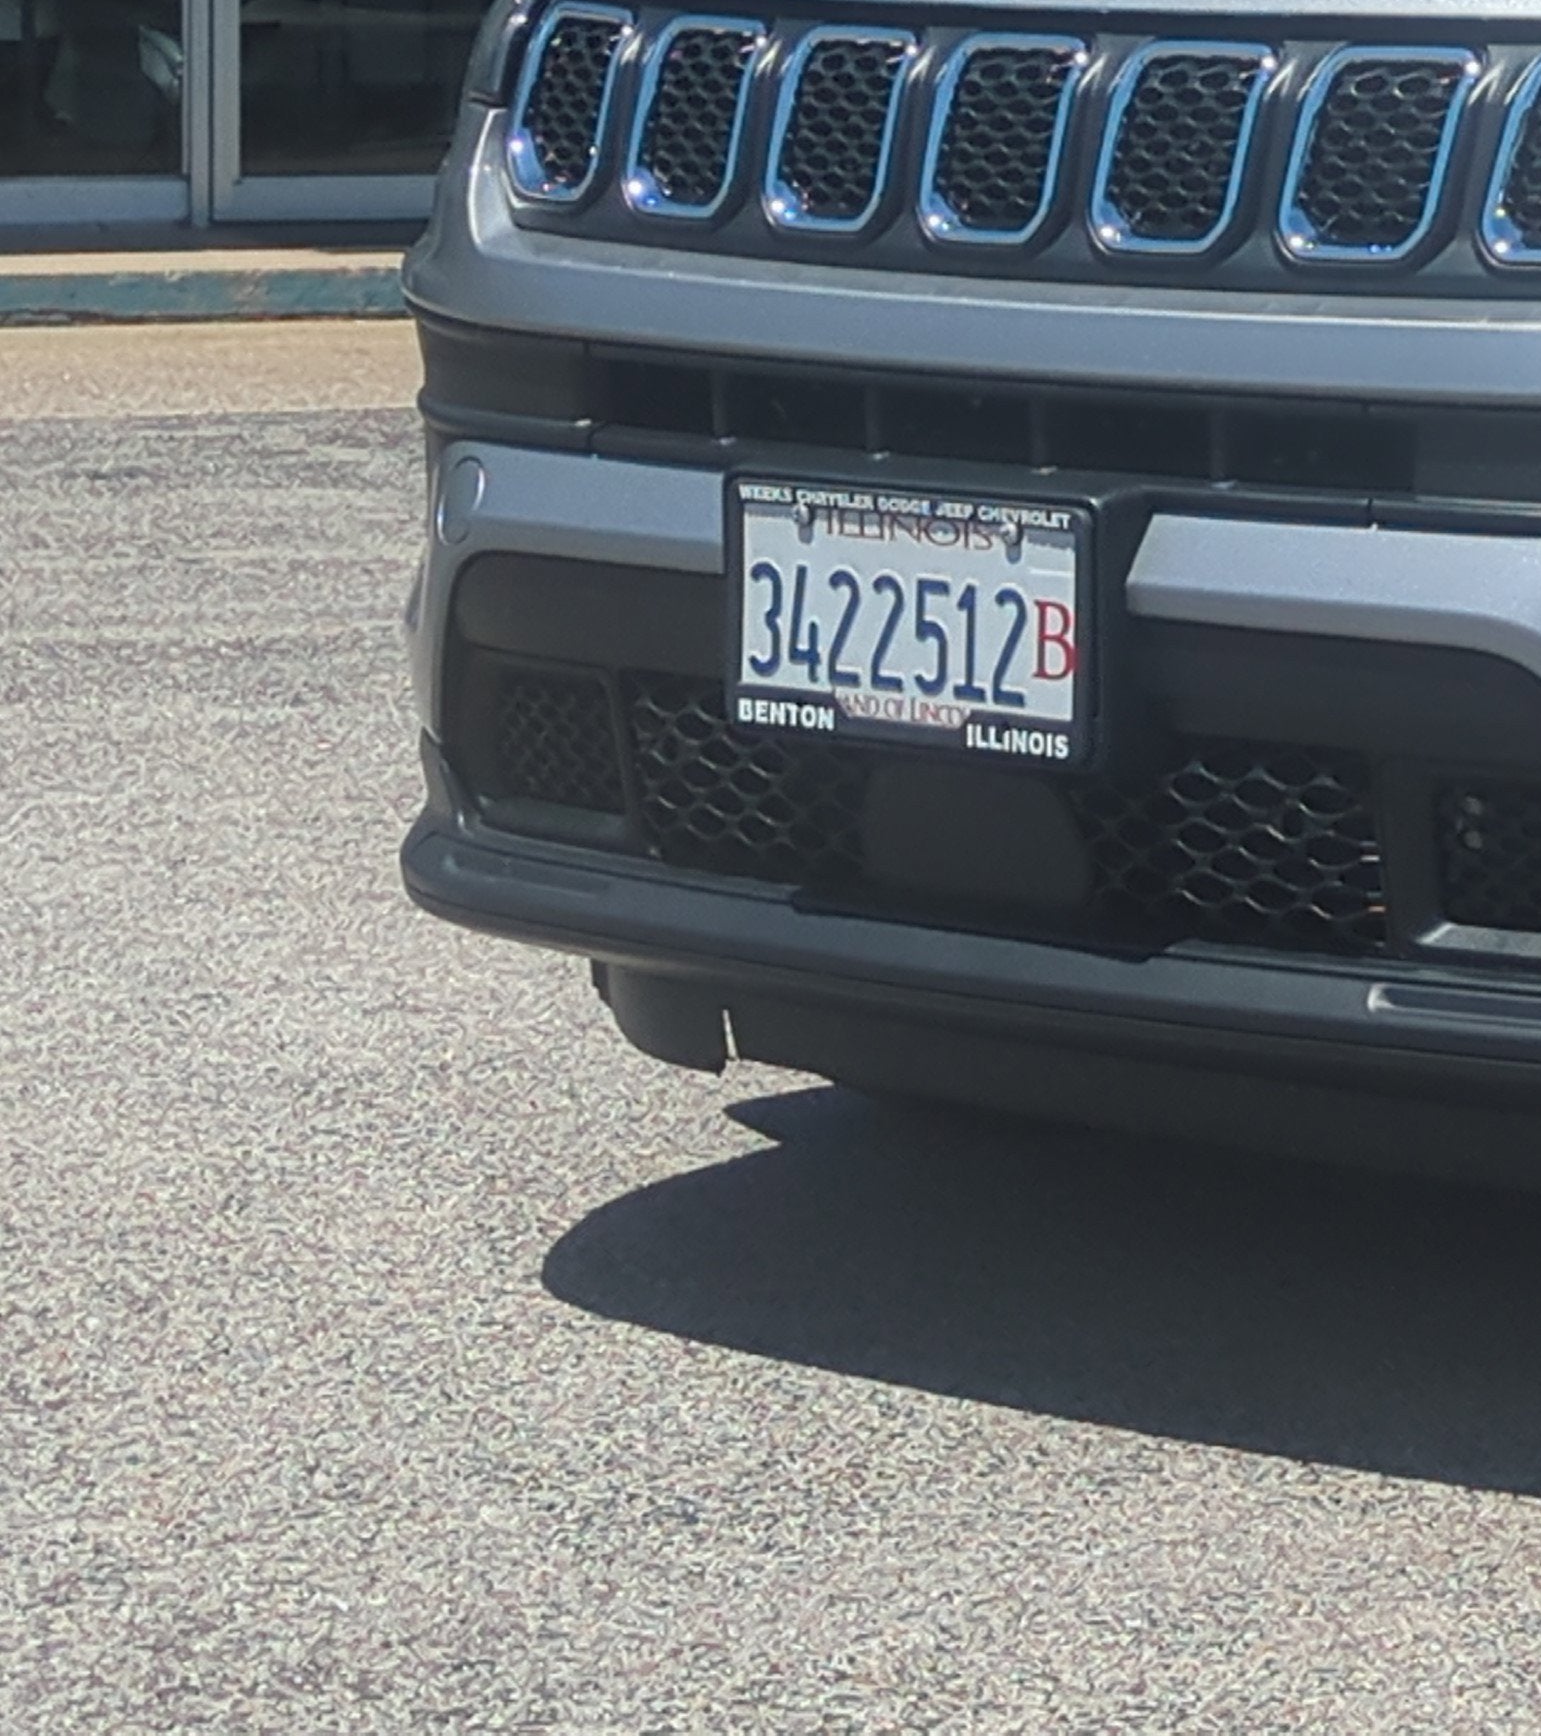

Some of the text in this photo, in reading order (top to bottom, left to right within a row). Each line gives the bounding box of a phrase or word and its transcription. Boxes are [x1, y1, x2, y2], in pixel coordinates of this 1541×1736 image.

[738, 484, 1072, 529] WEEKS CHRYSLER DODGE JEEP CHEVROLET
[826, 508, 994, 551] ILLINOIS
[738, 699, 836, 731] BENTON
[966, 724, 1070, 759] ILLINOIS
